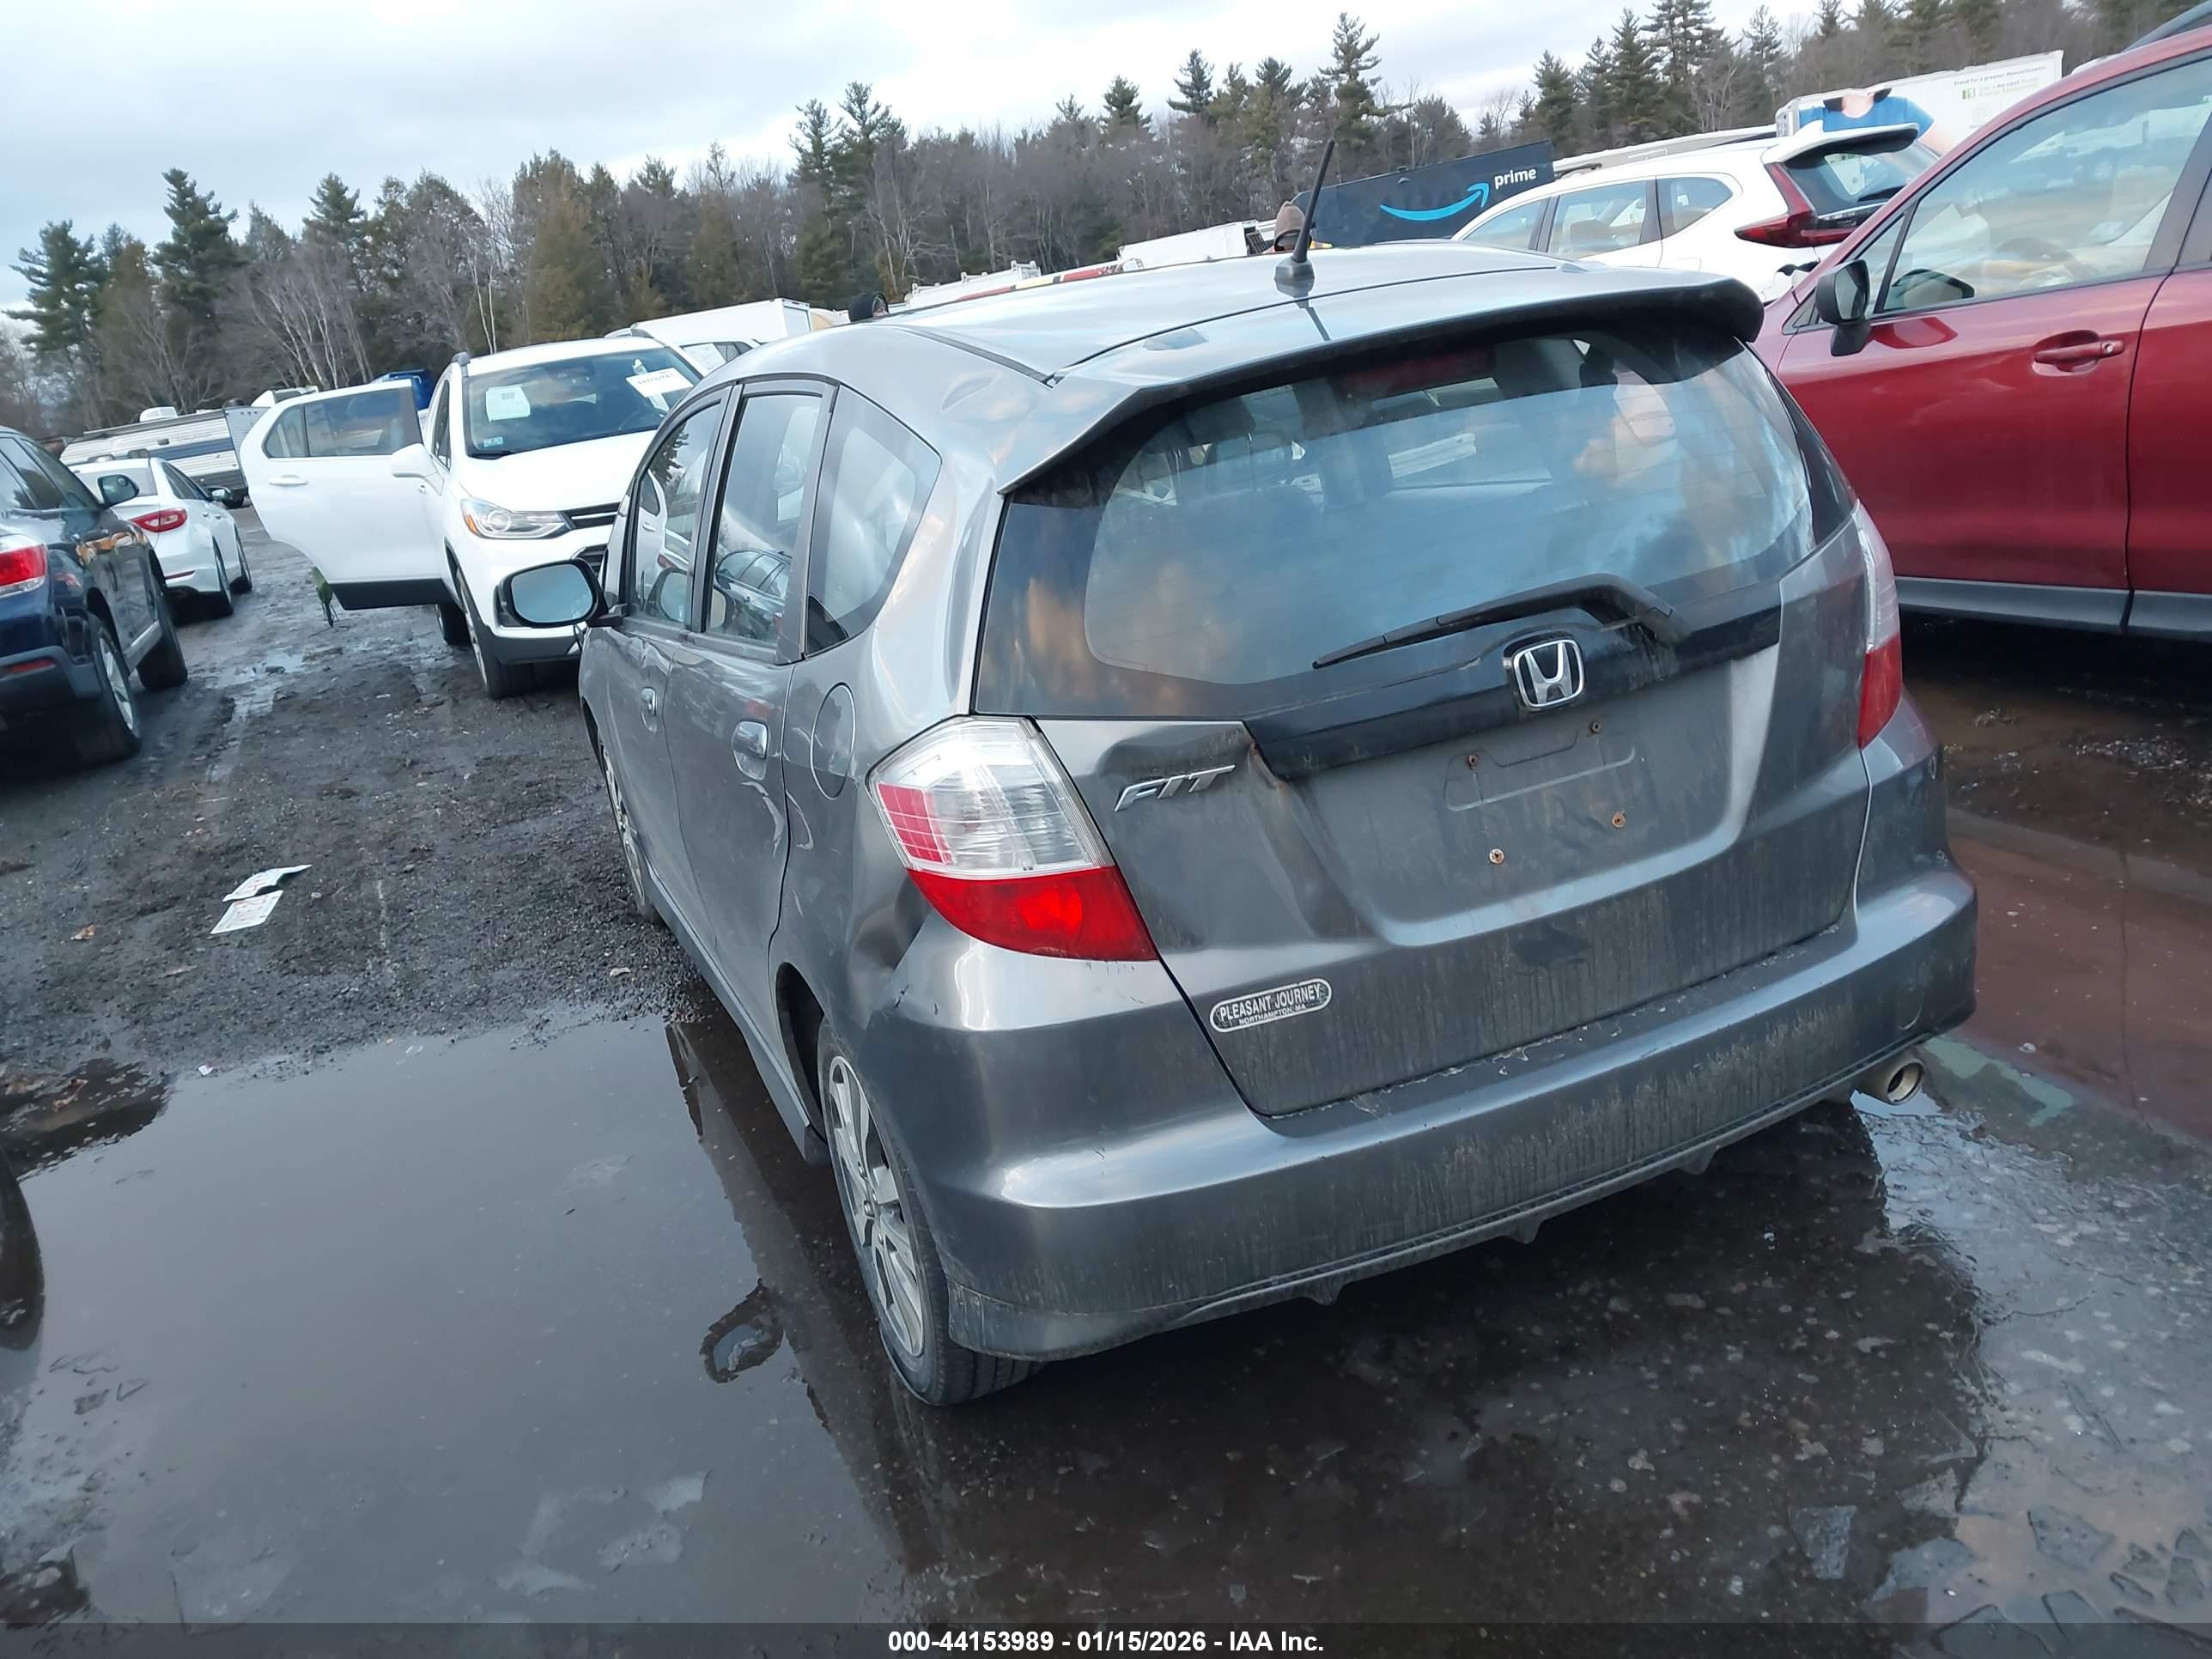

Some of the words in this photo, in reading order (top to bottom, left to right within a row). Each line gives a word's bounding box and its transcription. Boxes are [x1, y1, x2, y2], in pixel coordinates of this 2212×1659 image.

[1494, 168, 1537, 190] prime
[1114, 764, 1236, 811] FIT
[1219, 995, 1272, 1022] PLEASANT
[1274, 982, 1321, 1009] JOURNEY
